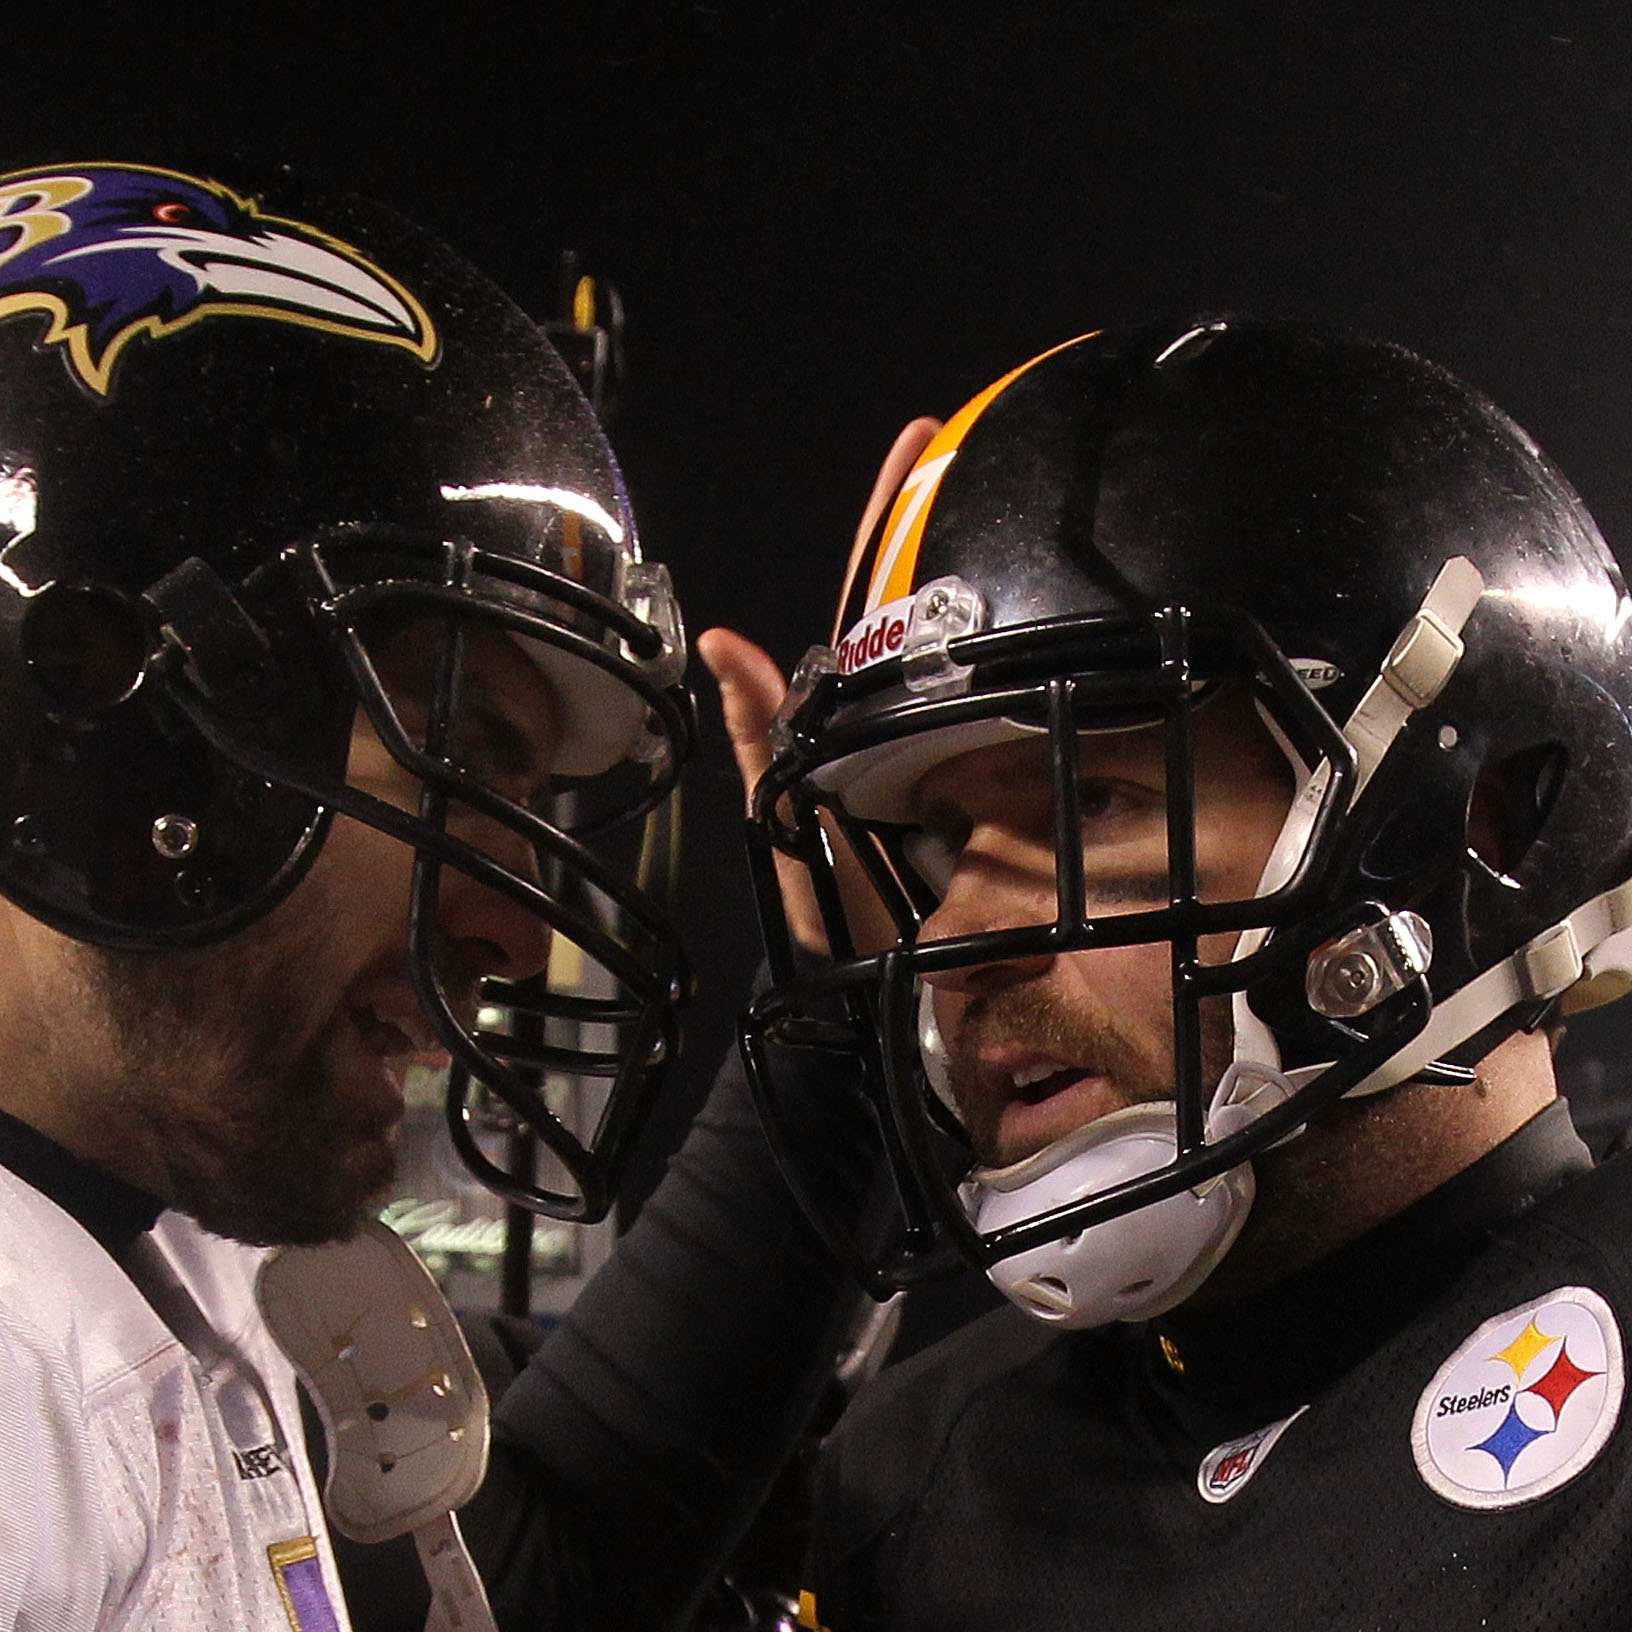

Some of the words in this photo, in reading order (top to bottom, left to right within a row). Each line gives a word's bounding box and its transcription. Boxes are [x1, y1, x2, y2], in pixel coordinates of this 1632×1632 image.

[863, 449, 958, 617] 7
[837, 617, 906, 674] Ridde
[1435, 1384, 1513, 1418] Steelers
